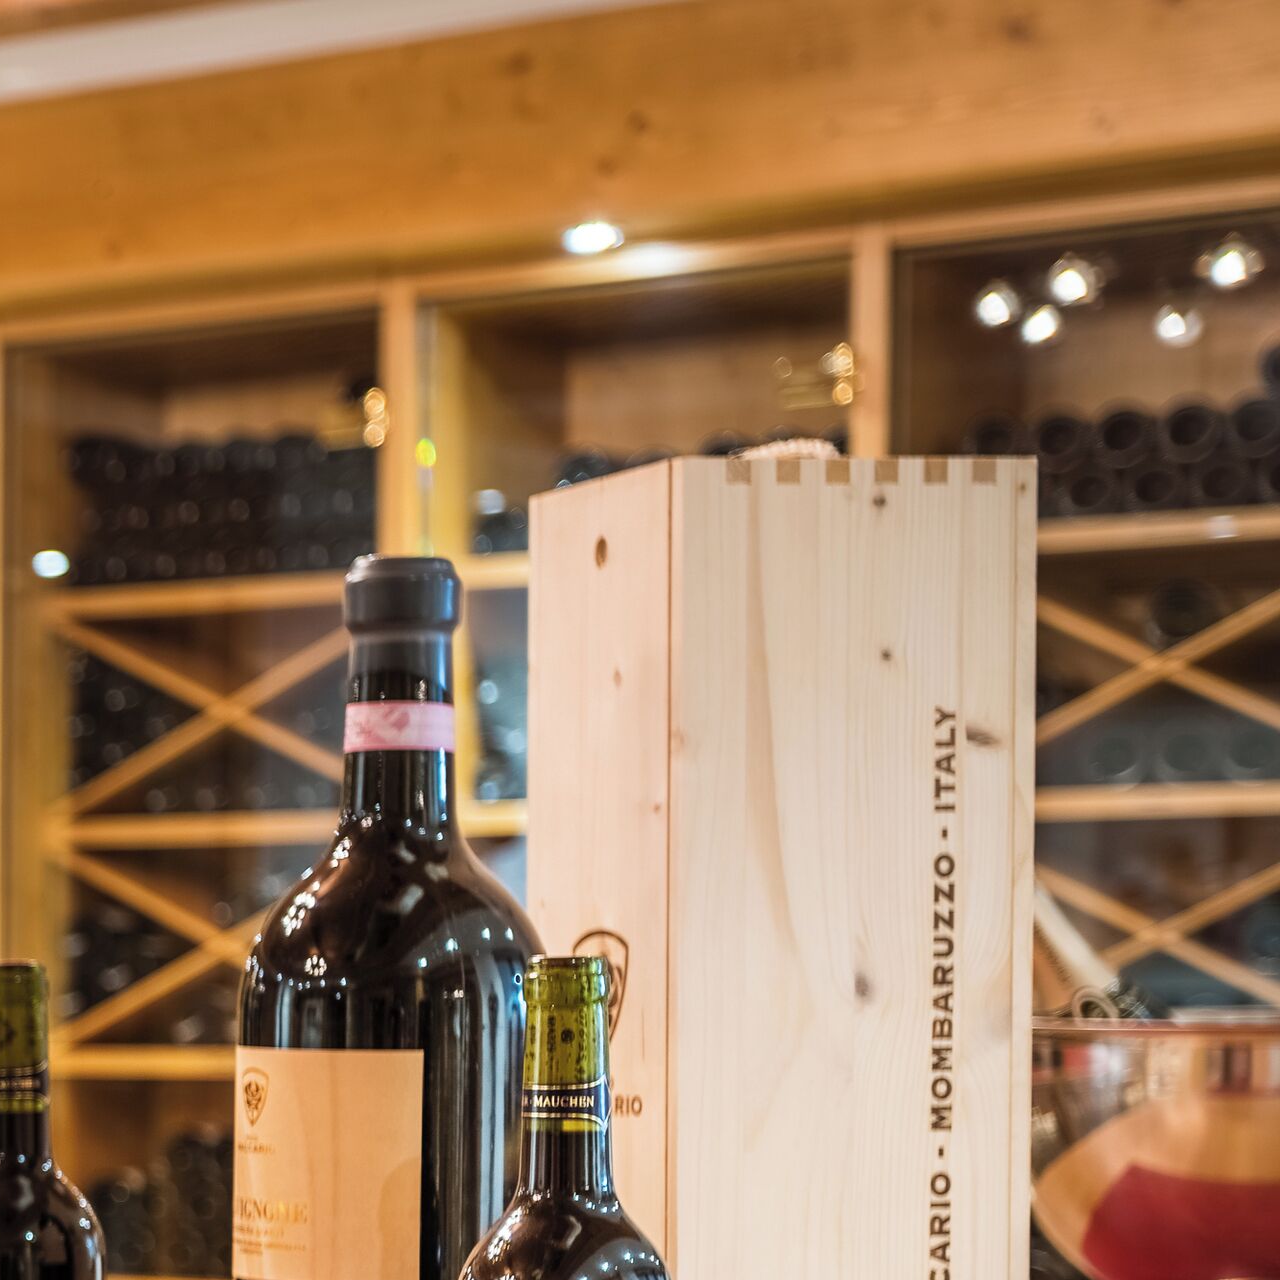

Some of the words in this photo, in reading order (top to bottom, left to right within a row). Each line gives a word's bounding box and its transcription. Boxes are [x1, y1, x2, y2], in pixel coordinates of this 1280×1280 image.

[934, 706, 957, 814] ITALY
[930, 853, 956, 1132] MOMBARUZZO
[533, 1094, 595, 1108] MAUCHEN
